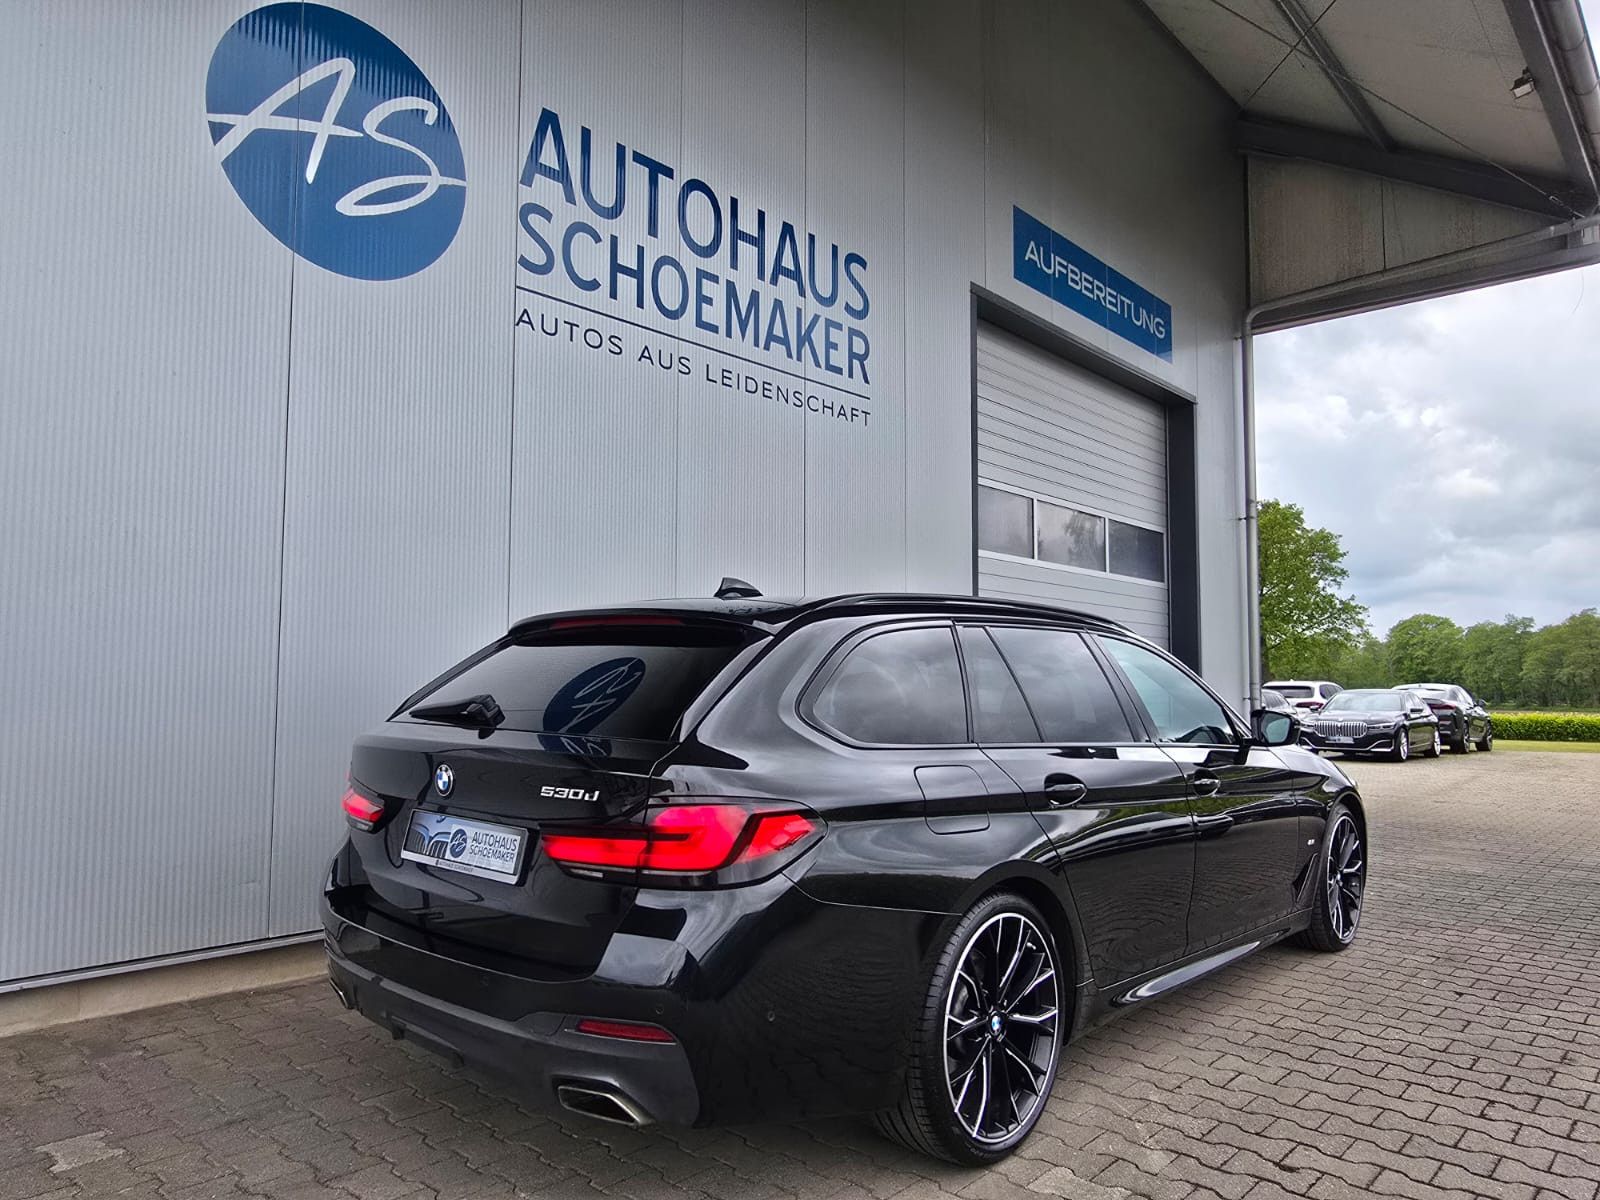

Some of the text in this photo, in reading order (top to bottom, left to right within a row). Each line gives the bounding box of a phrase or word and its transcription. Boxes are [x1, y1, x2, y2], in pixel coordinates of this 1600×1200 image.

[519, 107, 870, 321] AUTOHAUS
[517, 203, 871, 385] SCHOEMAKER
[1025, 240, 1166, 339] AUFBEREITUNG
[516, 308, 871, 426] AUTOS AUS LEIDENSCHAFT
[472, 832, 518, 851] AUTOHAUS
[540, 786, 600, 801] 530d
[469, 845, 515, 863] SCHOEMAKER
